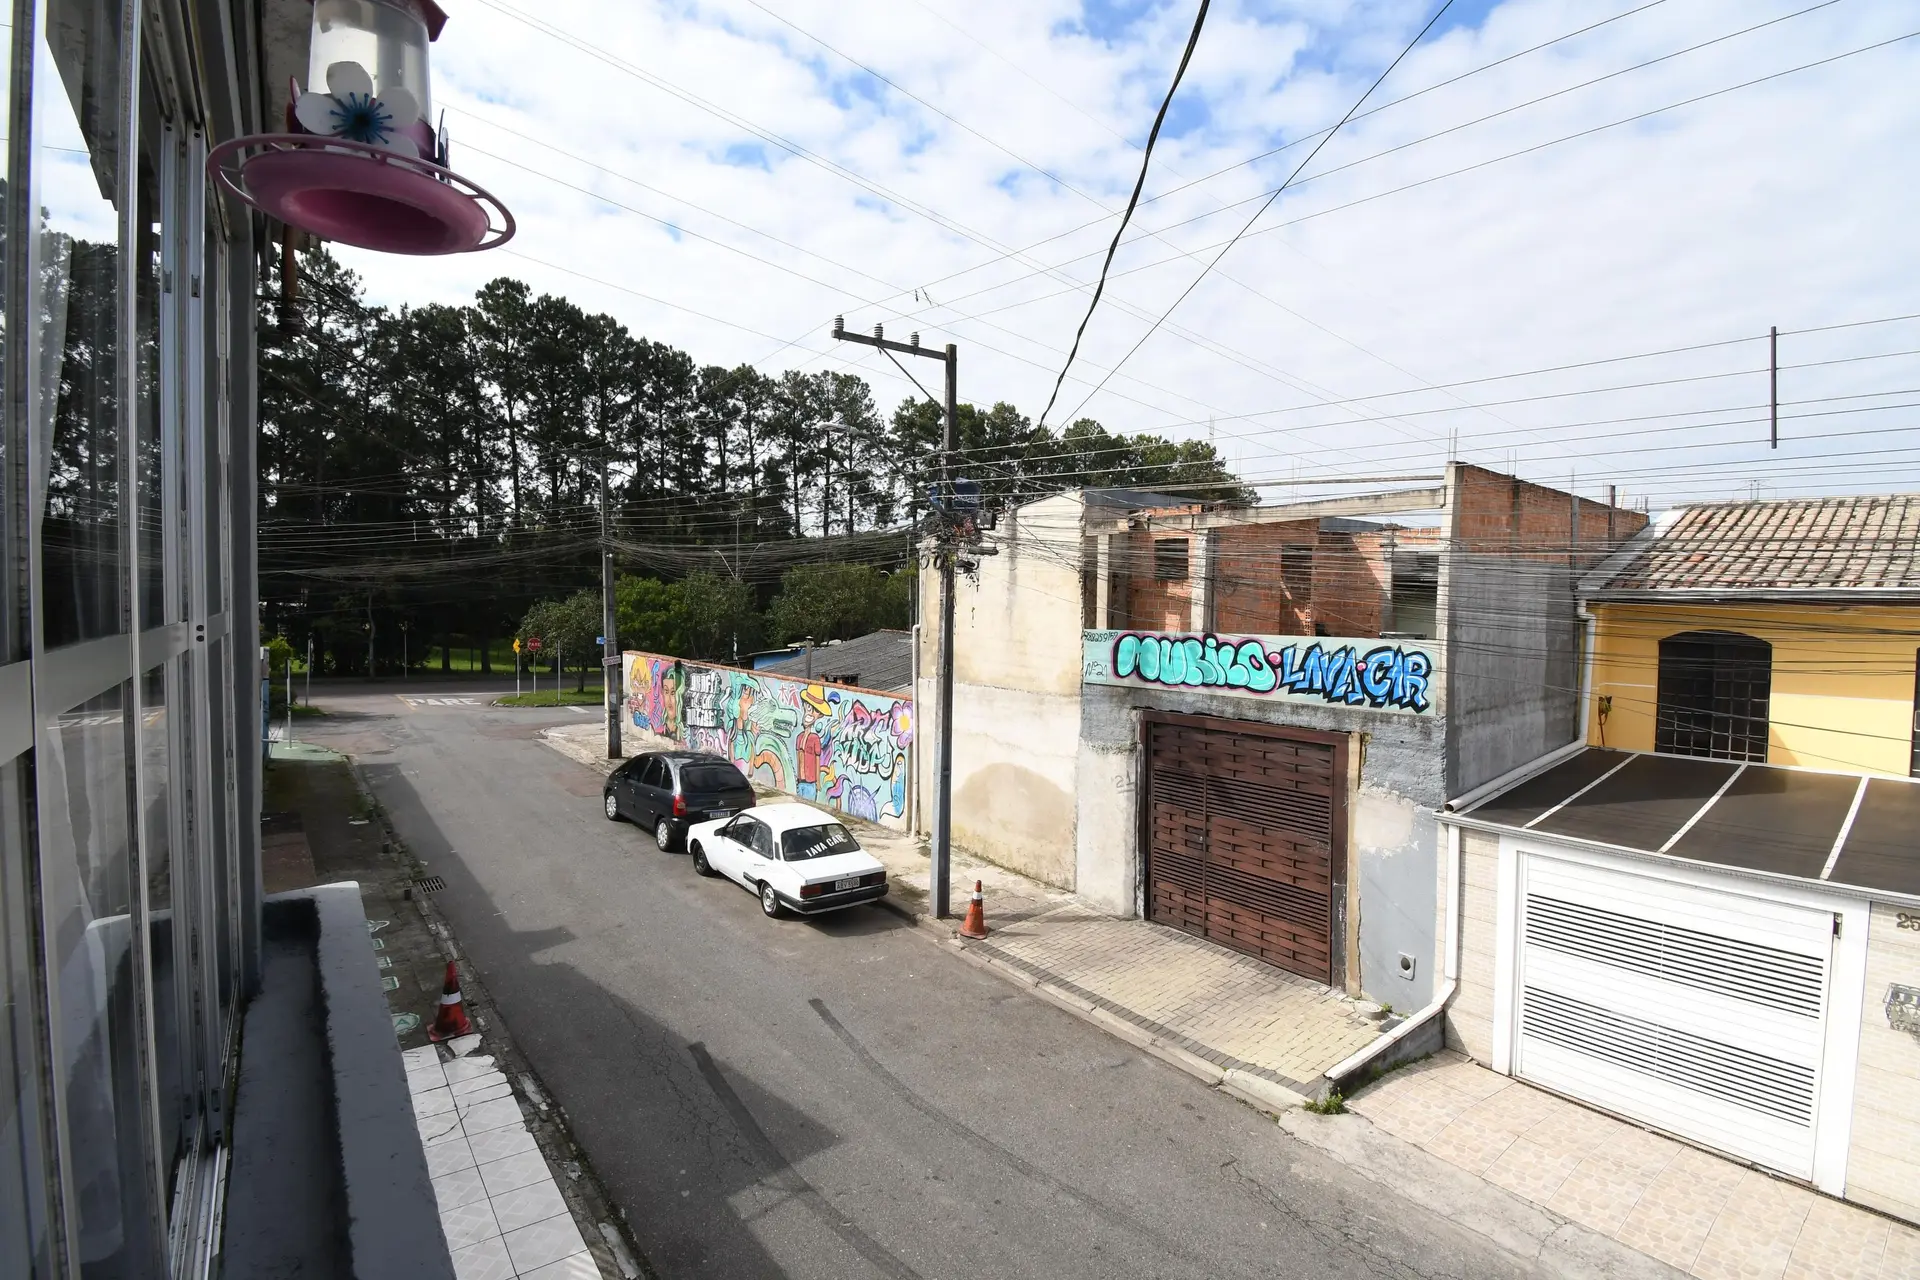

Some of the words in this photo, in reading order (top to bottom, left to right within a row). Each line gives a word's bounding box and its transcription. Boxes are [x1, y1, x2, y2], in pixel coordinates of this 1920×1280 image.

[1278, 641, 1365, 706] LAVA
[1362, 645, 1432, 714] CAR
[405, 698, 482, 706] PARE
